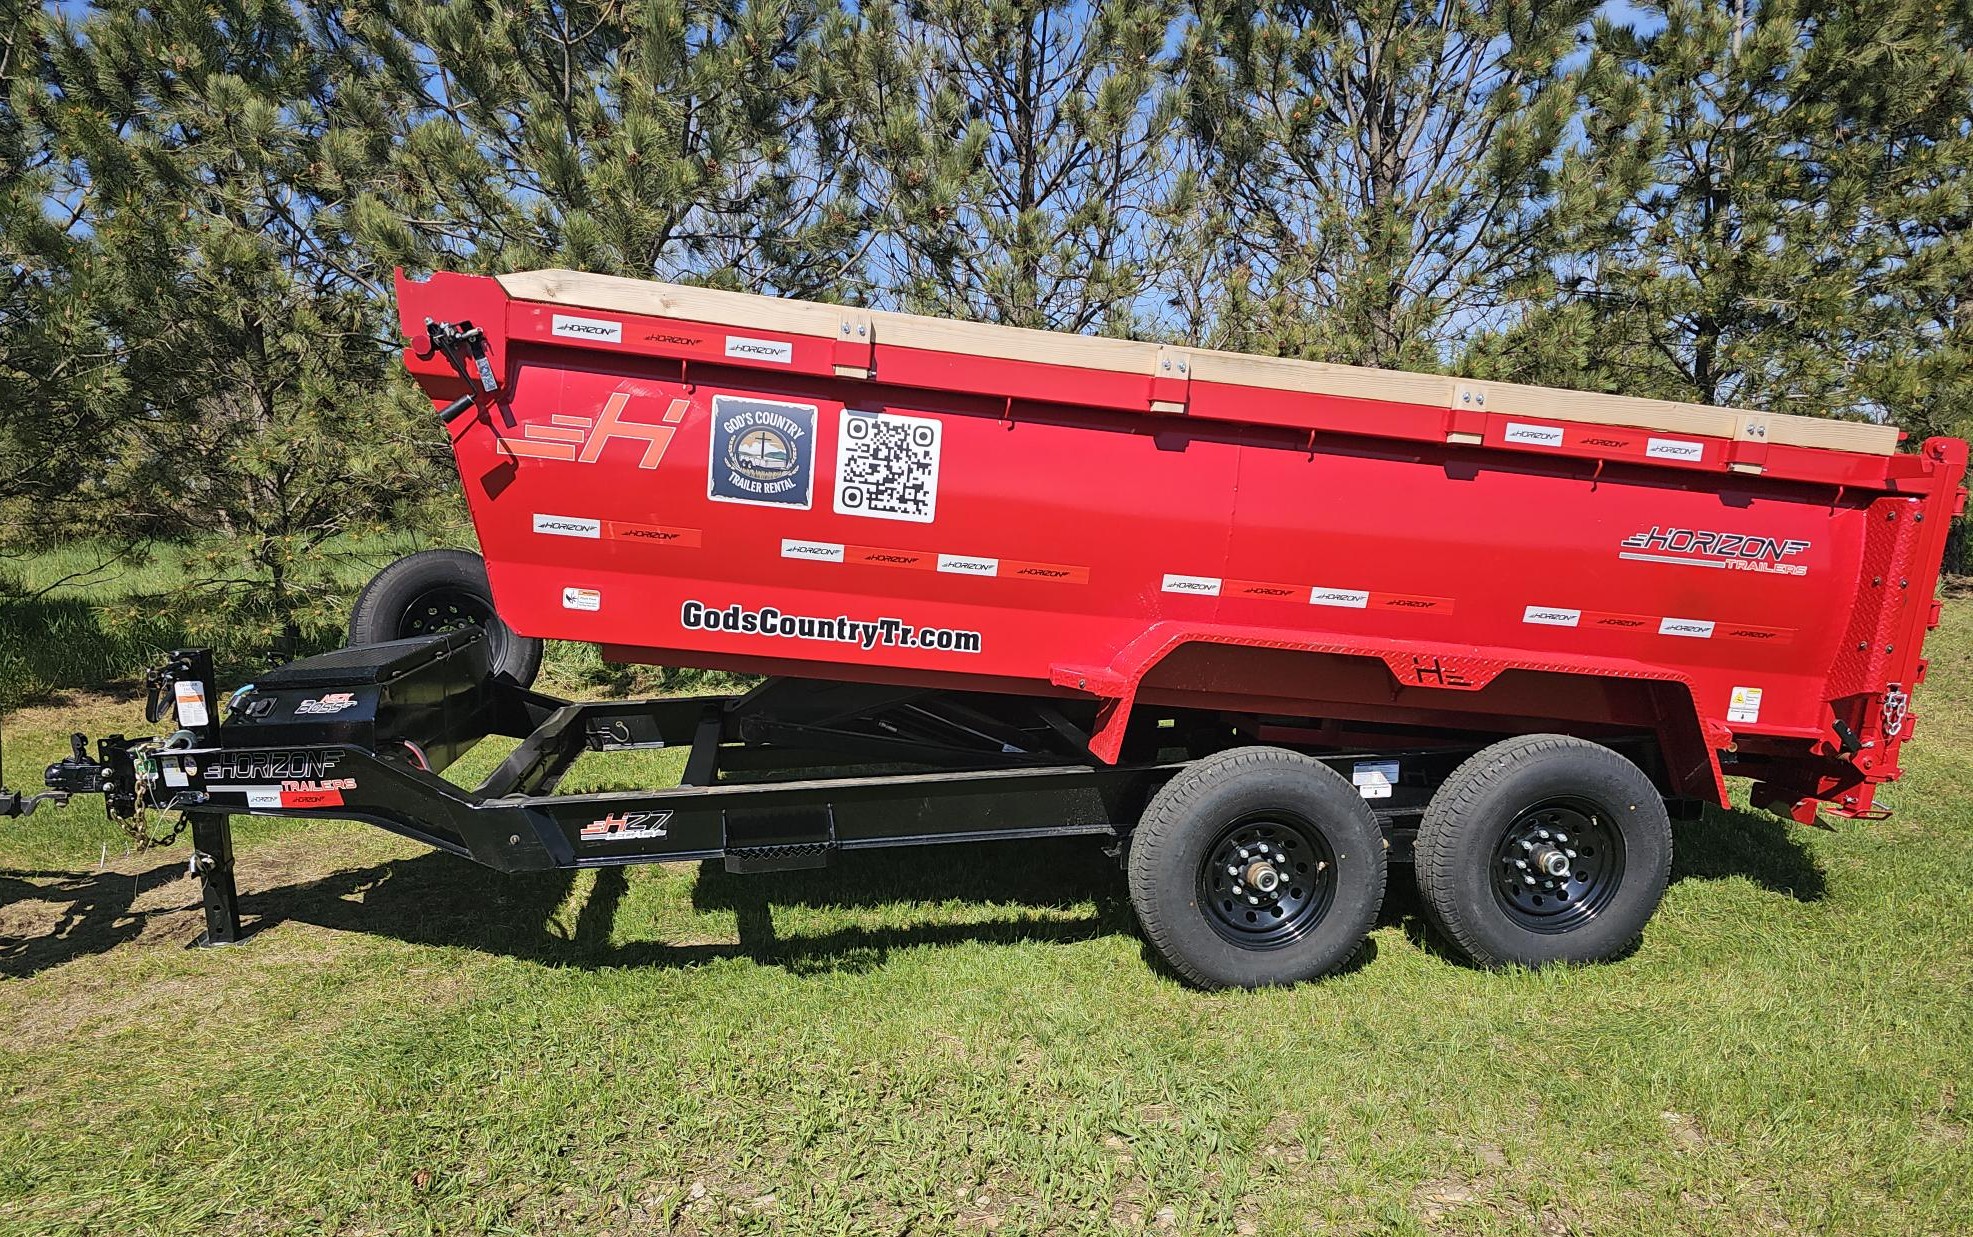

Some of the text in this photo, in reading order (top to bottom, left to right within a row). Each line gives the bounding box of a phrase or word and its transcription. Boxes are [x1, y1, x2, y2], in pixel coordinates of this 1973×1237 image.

[561, 322, 613, 336] HORIZON
[648, 333, 697, 347] HORIZON
[733, 344, 782, 357] HORIZON
[722, 411, 806, 441] GOD'S COUNTRY
[1515, 429, 1555, 441] HORIZON
[1584, 437, 1625, 449] HORIZON
[1654, 445, 1694, 456] HORIZON
[727, 474, 797, 494] TRAILER RENTAL
[544, 521, 592, 533] HORIZON
[627, 529, 675, 541] HORIZON
[1644, 526, 1791, 561] HORIZON
[792, 545, 836, 557] HORIZON
[870, 553, 915, 565] HORIZON
[946, 560, 991, 572] HORIZON
[1724, 558, 1808, 576] TRAILERS
[1021, 567, 1065, 579] HORIZON
[1171, 581, 1215, 592] HORIZON
[1248, 586, 1291, 597] HORIZON
[1319, 592, 1362, 603] HORIZON
[1390, 598, 1433, 609] HORIZON
[1533, 611, 1574, 622] HORIZON
[1602, 617, 1643, 628] HORIZON
[681, 599, 982, 653] GodsCountryTr.com
[1668, 623, 1708, 634] HORIZON
[216, 750, 328, 779] HORIZON
[281, 778, 358, 792] TRAILERS
